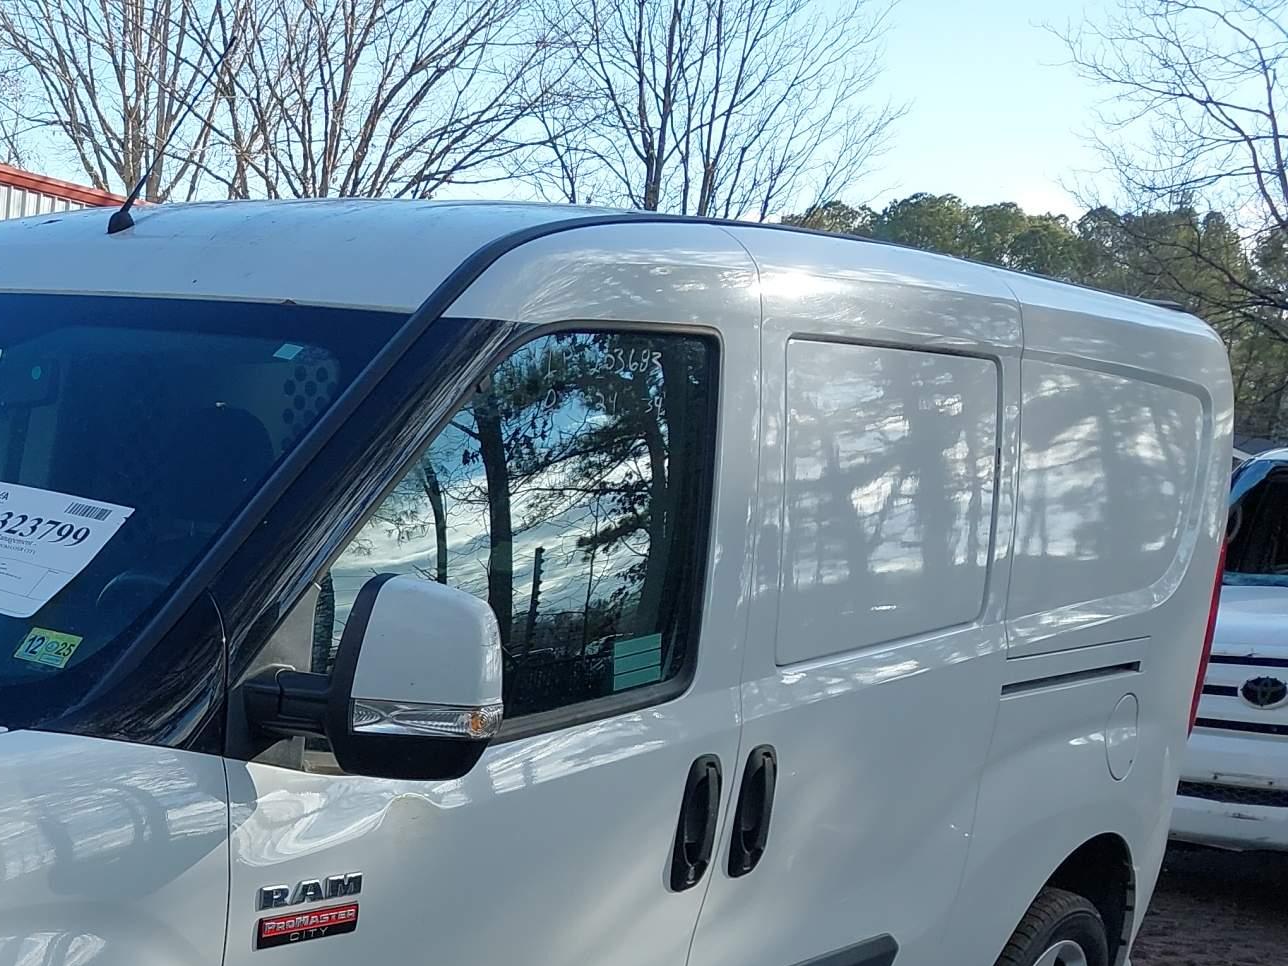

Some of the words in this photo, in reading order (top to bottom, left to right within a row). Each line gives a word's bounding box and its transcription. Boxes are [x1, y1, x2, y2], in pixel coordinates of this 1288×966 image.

[24, 635, 46, 655] 12
[54, 642, 75, 657] 25
[254, 870, 364, 912] RAM
[289, 926, 329, 942] CITY
